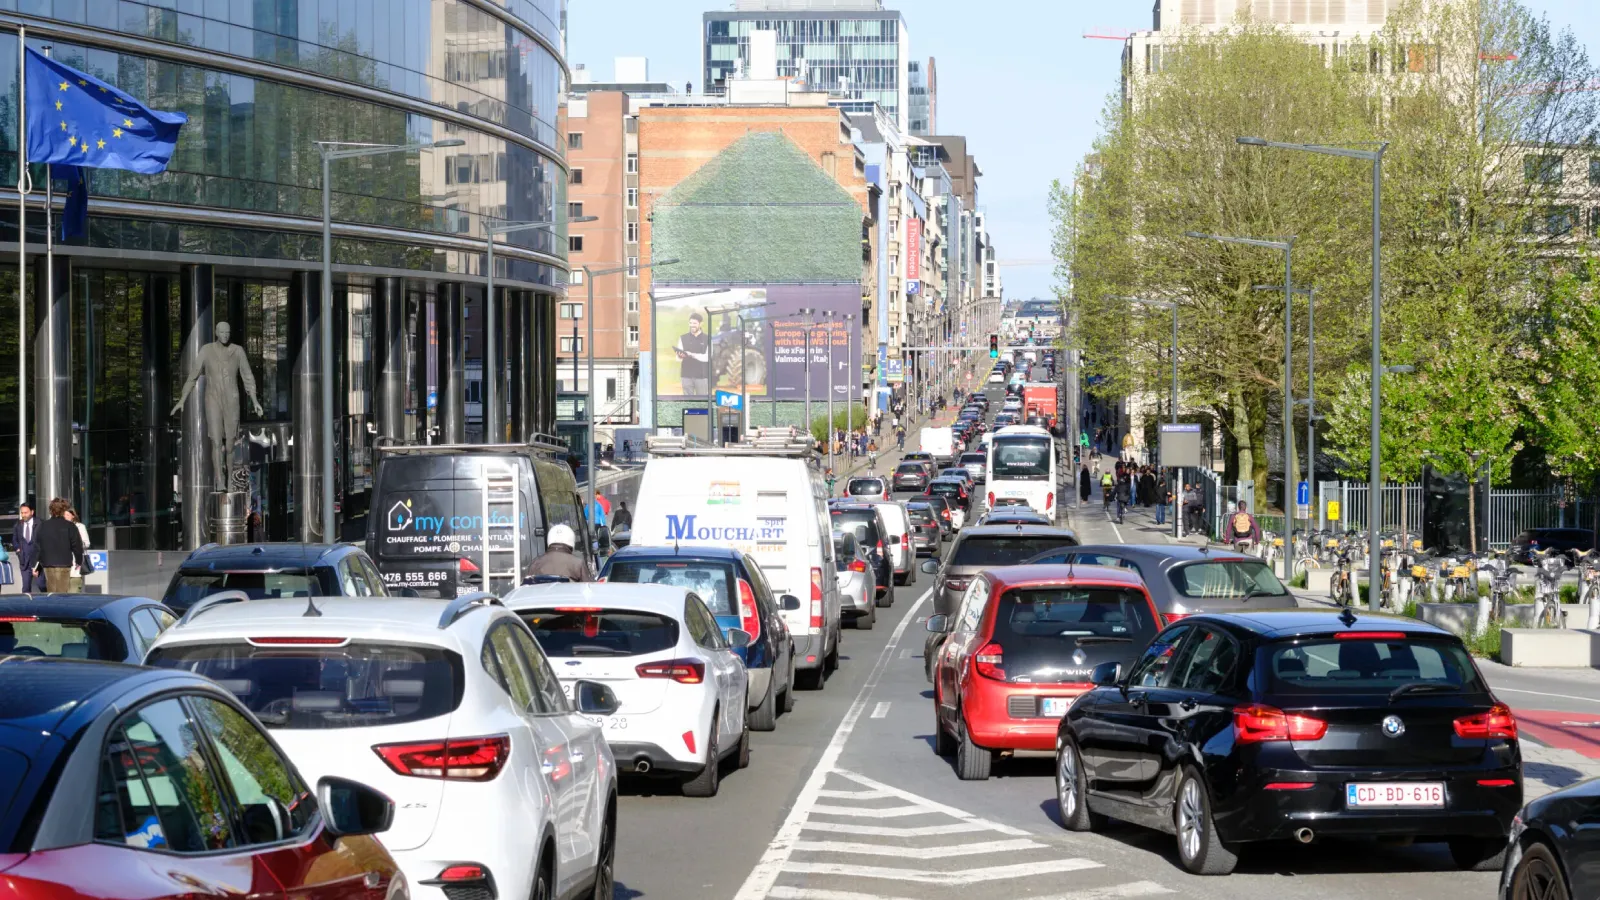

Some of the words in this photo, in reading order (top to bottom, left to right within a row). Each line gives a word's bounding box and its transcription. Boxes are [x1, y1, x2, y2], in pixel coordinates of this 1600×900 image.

[909, 228, 917, 248] Thon
[909, 250, 917, 276] Hotels
[775, 330, 801, 338] Europe
[775, 355, 813, 363] Valmacc,
[415, 515, 444, 534] my
[413, 545, 442, 553] POMPE
[461, 544, 501, 552] CHALUR
[90, 553, 101, 567] P
[405, 573, 424, 581] 555
[428, 572, 447, 581] 666
